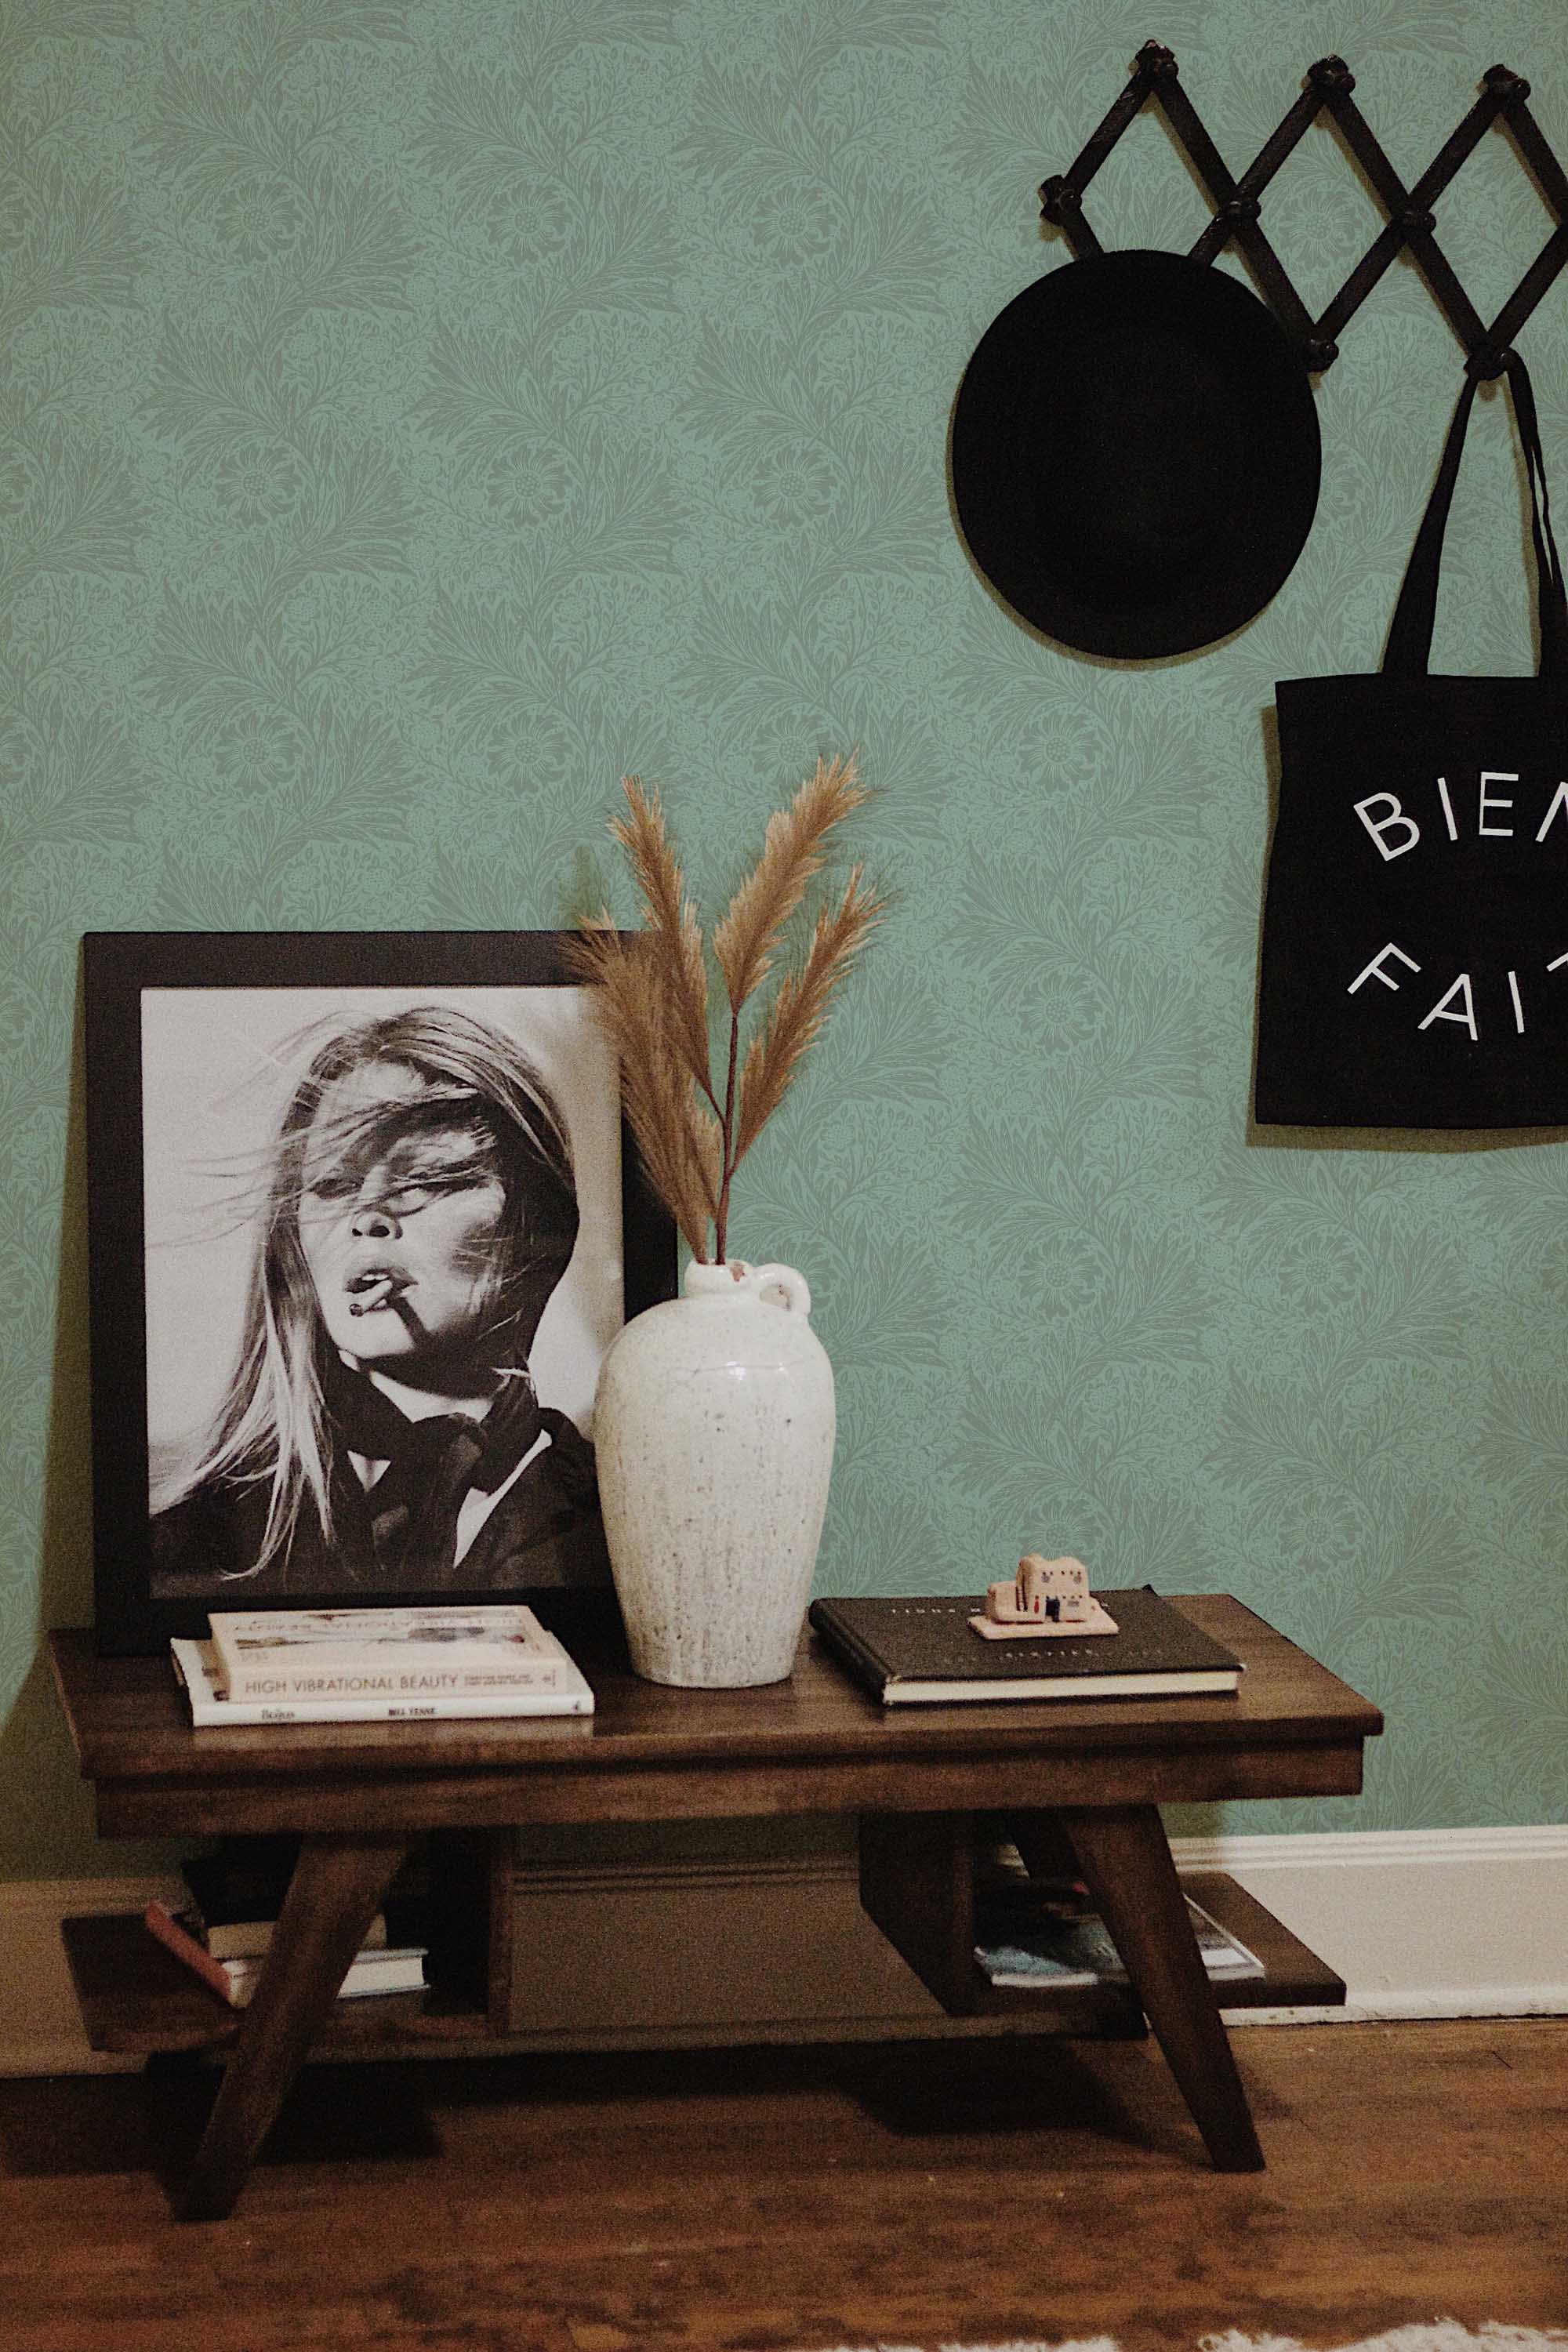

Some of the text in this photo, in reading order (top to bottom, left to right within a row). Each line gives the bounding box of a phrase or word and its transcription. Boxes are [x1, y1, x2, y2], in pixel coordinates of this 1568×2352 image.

[245, 1679, 287, 1693] HIGH
[292, 1675, 392, 1693] VIBRATIONAL
[400, 1673, 459, 1690] BEAUTY
